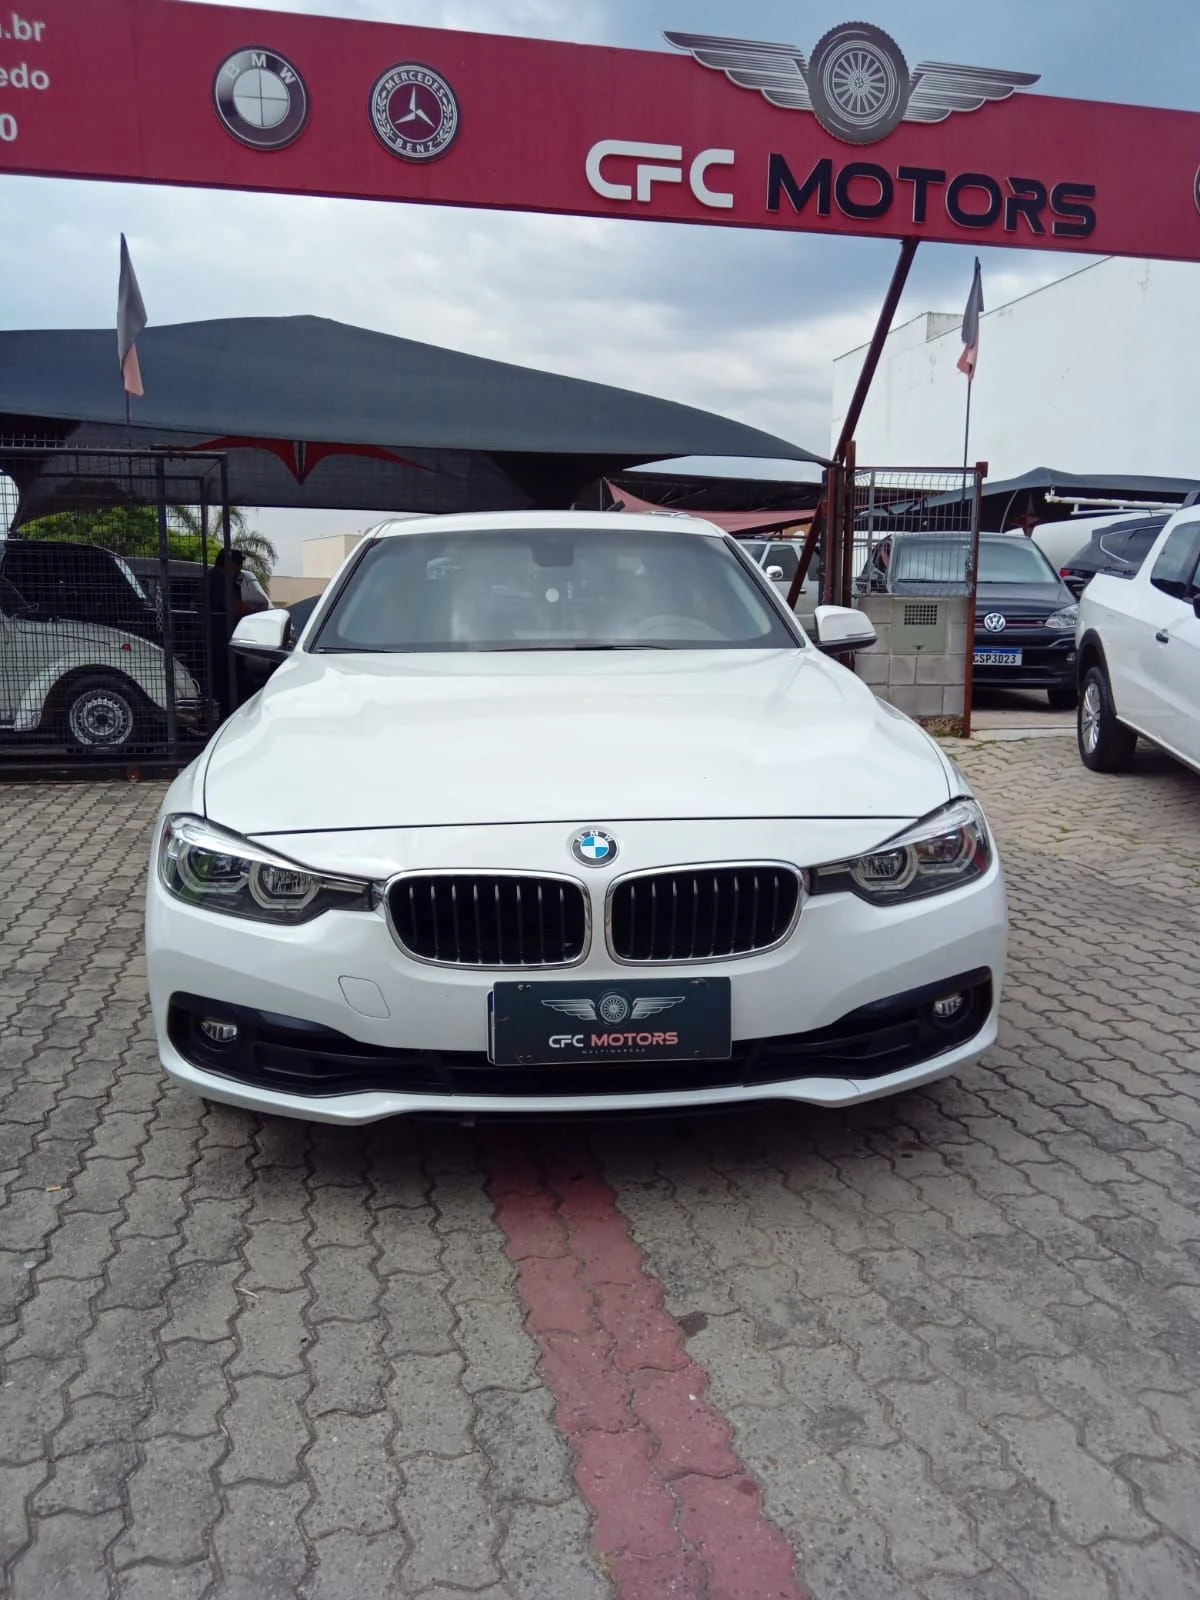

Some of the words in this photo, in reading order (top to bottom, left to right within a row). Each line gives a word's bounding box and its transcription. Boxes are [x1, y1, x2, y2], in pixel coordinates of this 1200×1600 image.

[0, 12, 46, 41] .br
[225, 53, 297, 84] BMW
[384, 71, 446, 98] MERCEDES
[395, 138, 436, 154] BENZ
[585, 139, 735, 208] CFC
[766, 153, 1097, 237] MOTORS
[576, 829, 613, 842] BMW
[548, 1034, 585, 1048] CFC
[591, 1031, 679, 1046] MOTORS
